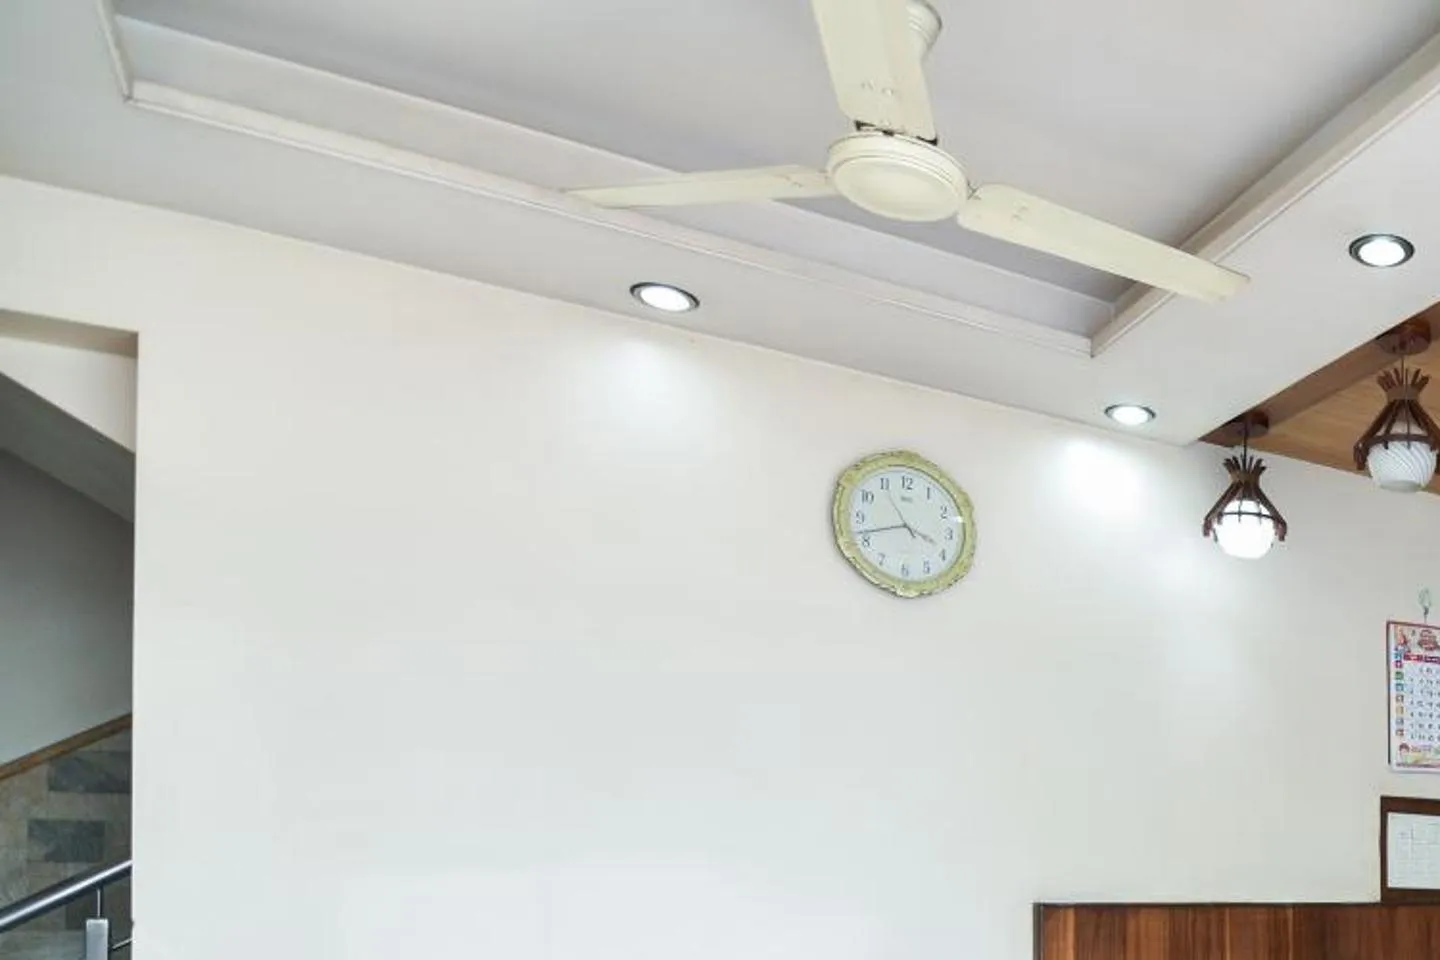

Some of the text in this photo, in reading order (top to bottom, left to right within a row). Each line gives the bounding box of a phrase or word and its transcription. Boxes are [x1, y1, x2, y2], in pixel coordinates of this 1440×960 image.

[880, 477, 890, 491] 11
[901, 475, 914, 490] 12
[860, 490, 875, 504] 10
[926, 487, 931, 500] 1
[855, 512, 865, 525] 9
[940, 505, 948, 519] 2
[944, 528, 953, 541] 3
[861, 535, 871, 548] 8
[877, 553, 886, 566] 7
[938, 549, 946, 561] 4
[901, 564, 909, 576] 6
[923, 561, 931, 574] 5
